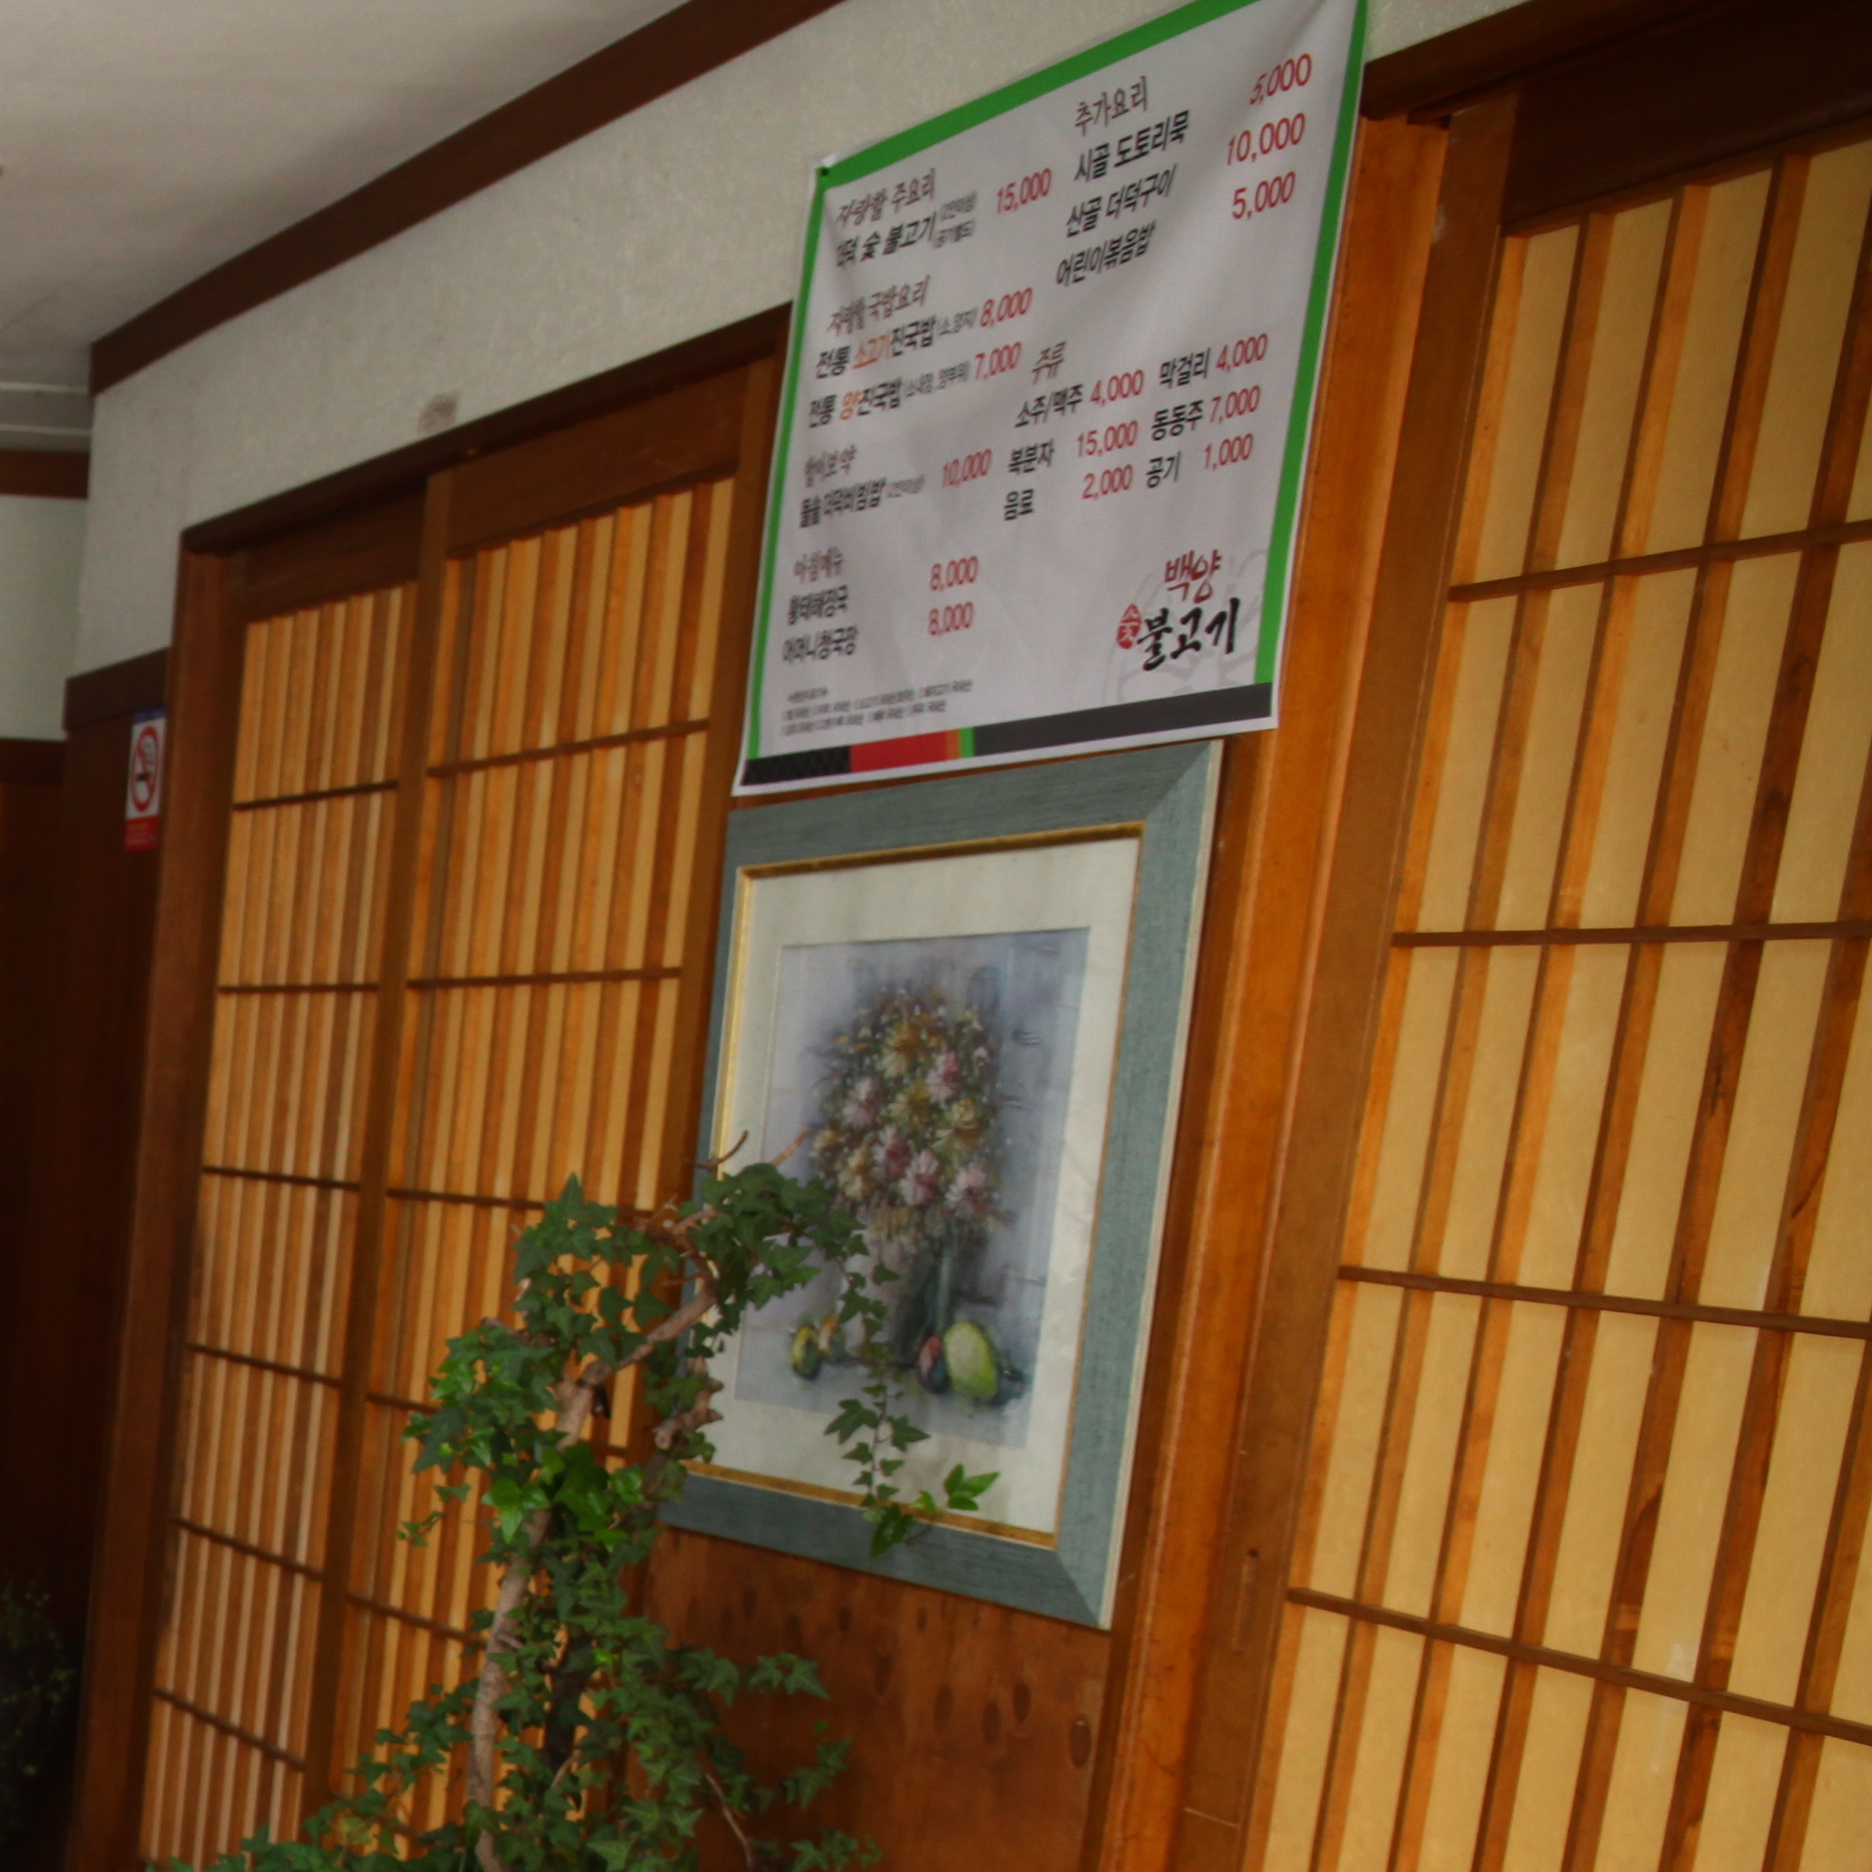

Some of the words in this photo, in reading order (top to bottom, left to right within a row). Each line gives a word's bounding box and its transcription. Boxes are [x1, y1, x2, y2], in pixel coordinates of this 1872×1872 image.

[1074, 75, 1148, 137] 추가요리
[1074, 142, 1111, 182] 시골
[1113, 110, 1189, 168] 도토리묵
[1249, 53, 1313, 105] 5,000
[882, 211, 937, 255] 불고기
[996, 167, 1052, 214] 15,000
[1066, 196, 1103, 238] 산골
[1105, 164, 1178, 219] 더덕구이
[1227, 112, 1306, 166] 10,000
[1056, 220, 1157, 287] 어린이볶음밥
[1231, 171, 1296, 220] 5,000
[816, 345, 851, 379] 전통
[979, 287, 1033, 328] 8,000
[974, 342, 1022, 381] 7,000
[1032, 341, 1066, 384] 주류
[1014, 383, 1084, 429] 소주/맥주
[1090, 369, 1145, 406] 4,000
[1159, 347, 1212, 389] 막걸리
[1216, 333, 1268, 372] 4,000
[942, 448, 993, 488] 10,000
[1007, 439, 1055, 475] 복분자
[1077, 420, 1139, 459] 15,000
[1151, 399, 1204, 442] 동동주
[1209, 385, 1261, 424] 7,000
[1003, 489, 1034, 521] 음료
[1082, 465, 1134, 501] 2,000
[1146, 451, 1181, 489] 공기
[1204, 433, 1254, 471] 1,000
[930, 555, 979, 592] 8,000
[1164, 549, 1222, 603] 백양
[928, 601, 974, 637] 8,000
[1137, 597, 1240, 671] 불고기
